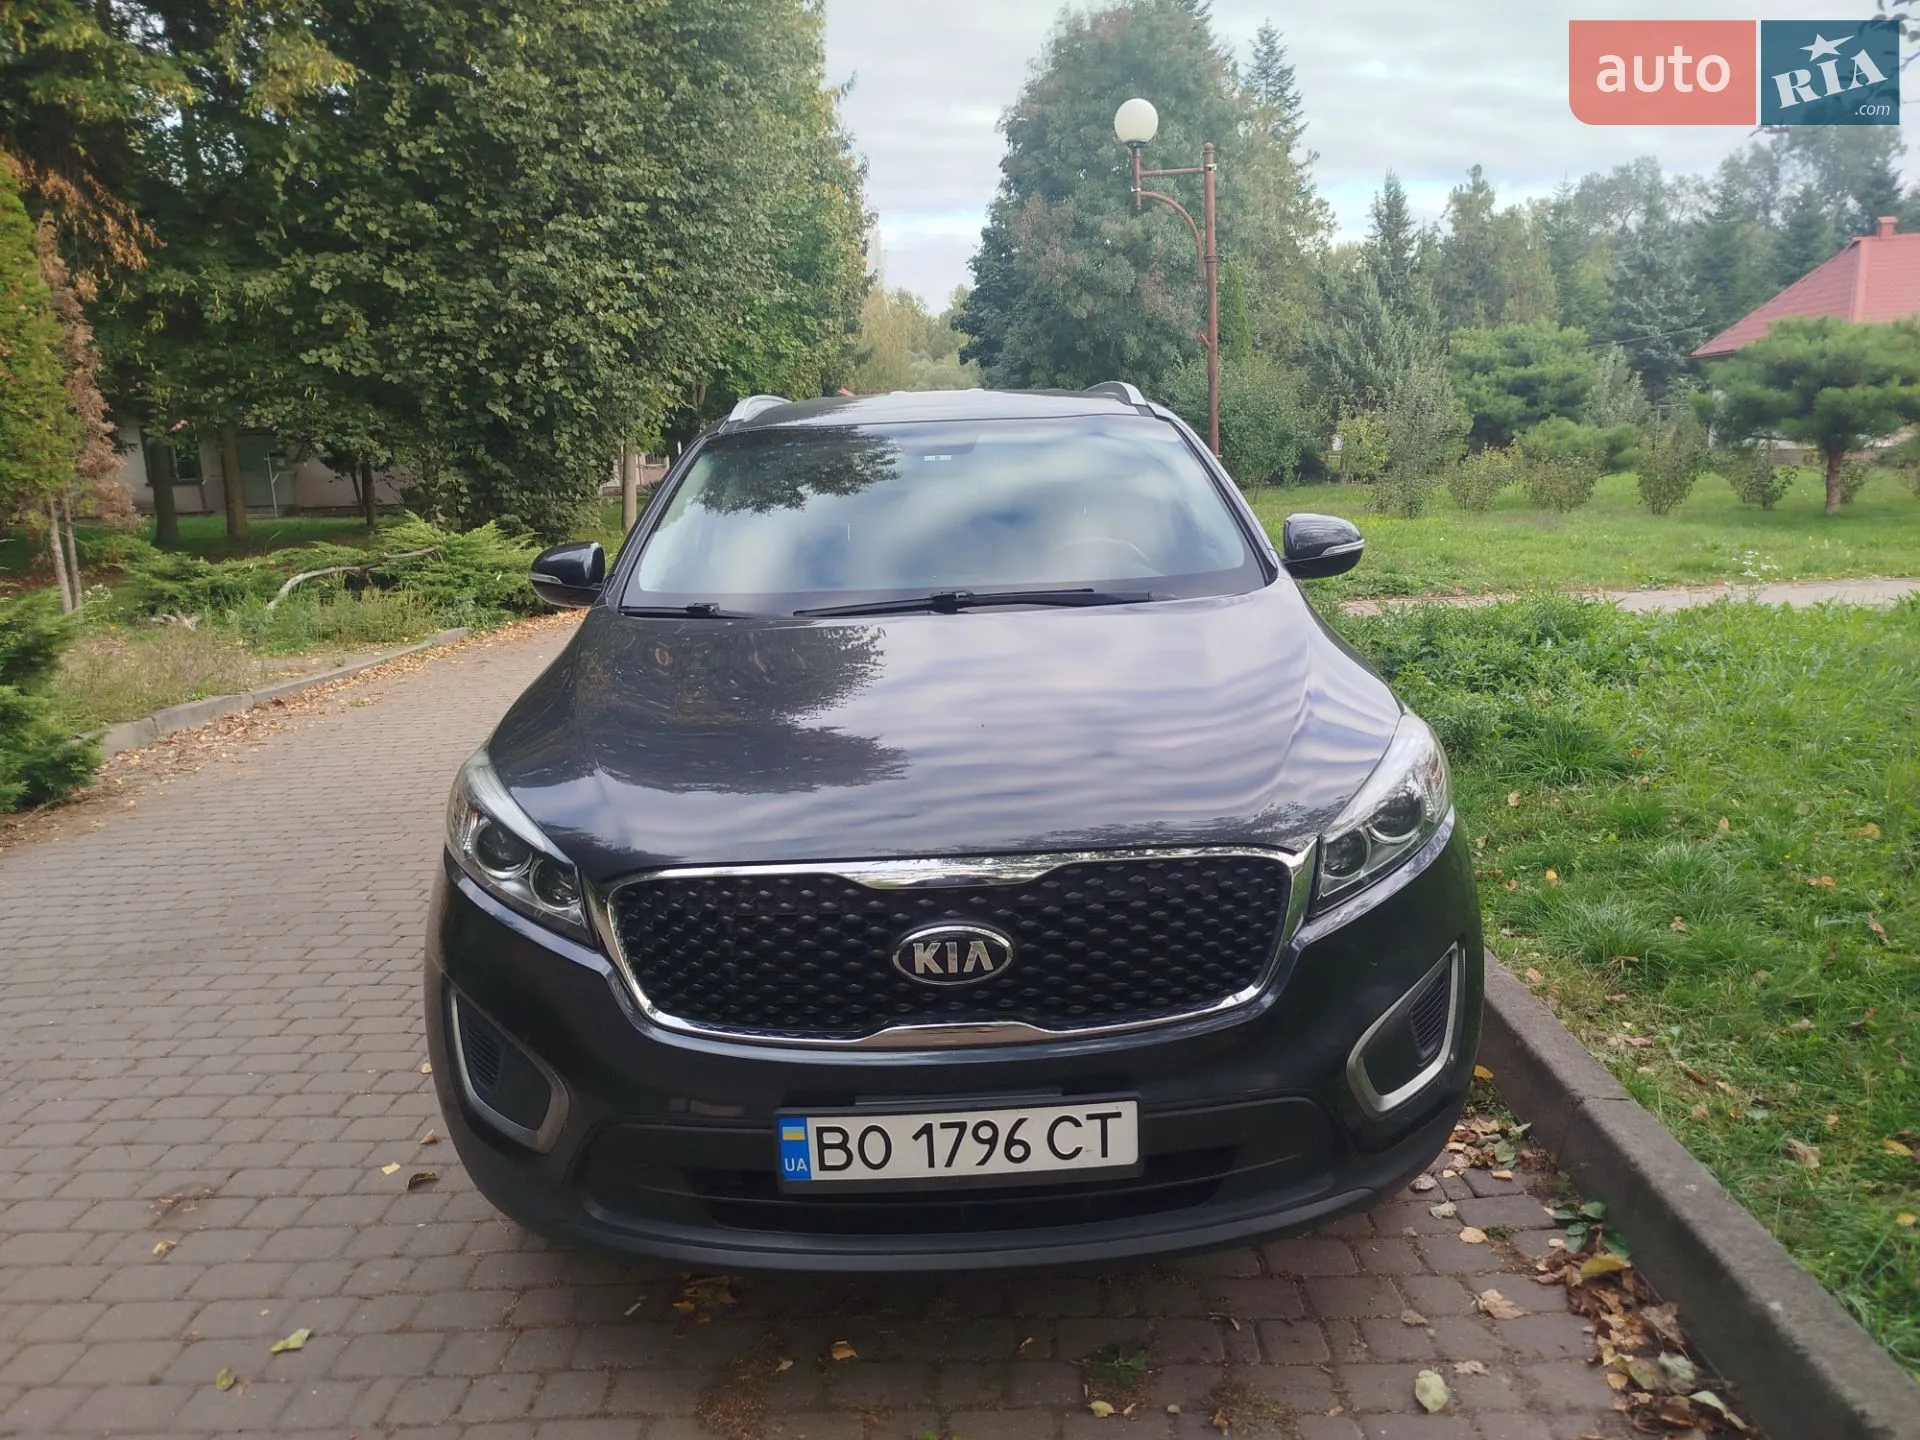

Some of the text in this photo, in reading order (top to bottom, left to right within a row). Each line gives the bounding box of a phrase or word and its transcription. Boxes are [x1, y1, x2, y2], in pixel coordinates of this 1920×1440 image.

[913, 941, 994, 974] KIA
[815, 1112, 1122, 1172] BO 1796 CT
[785, 1158, 808, 1172] UA
